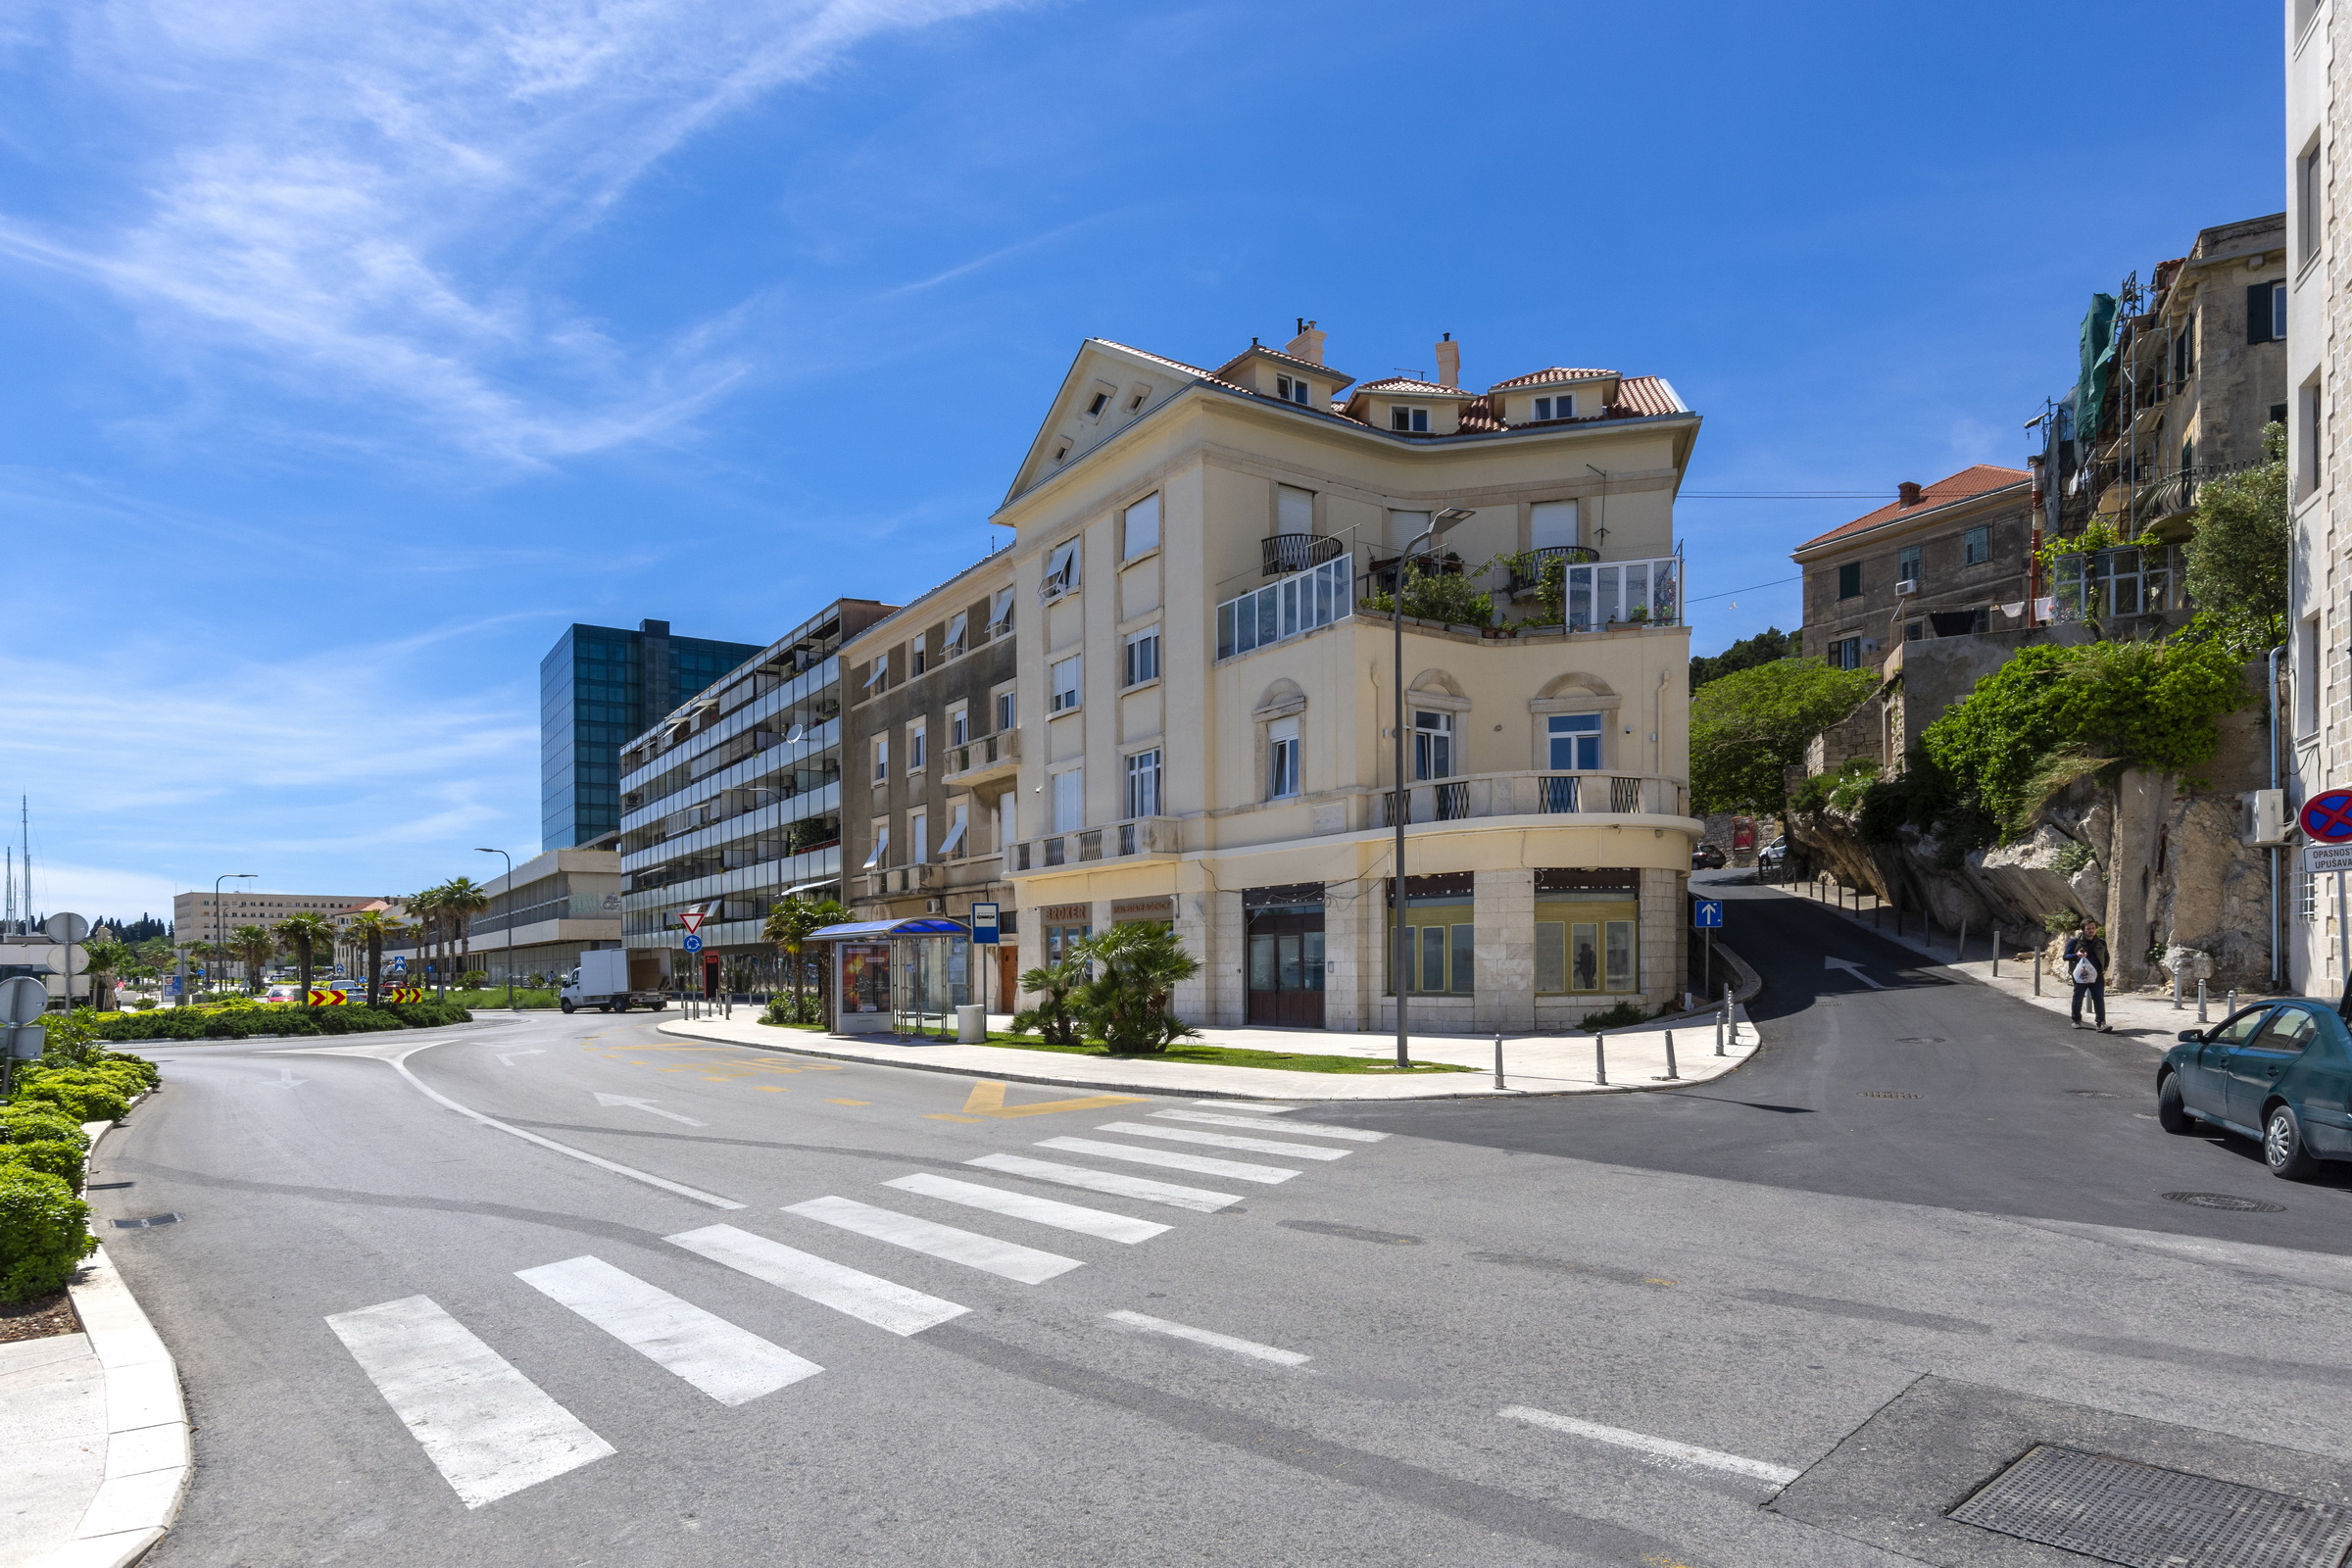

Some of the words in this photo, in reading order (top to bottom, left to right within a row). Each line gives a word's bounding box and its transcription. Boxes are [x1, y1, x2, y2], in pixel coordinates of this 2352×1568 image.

[1047, 905, 1086, 920] BROKER
[1145, 901, 1171, 911] AGENCY
[669, 1057, 845, 1077] BUS
